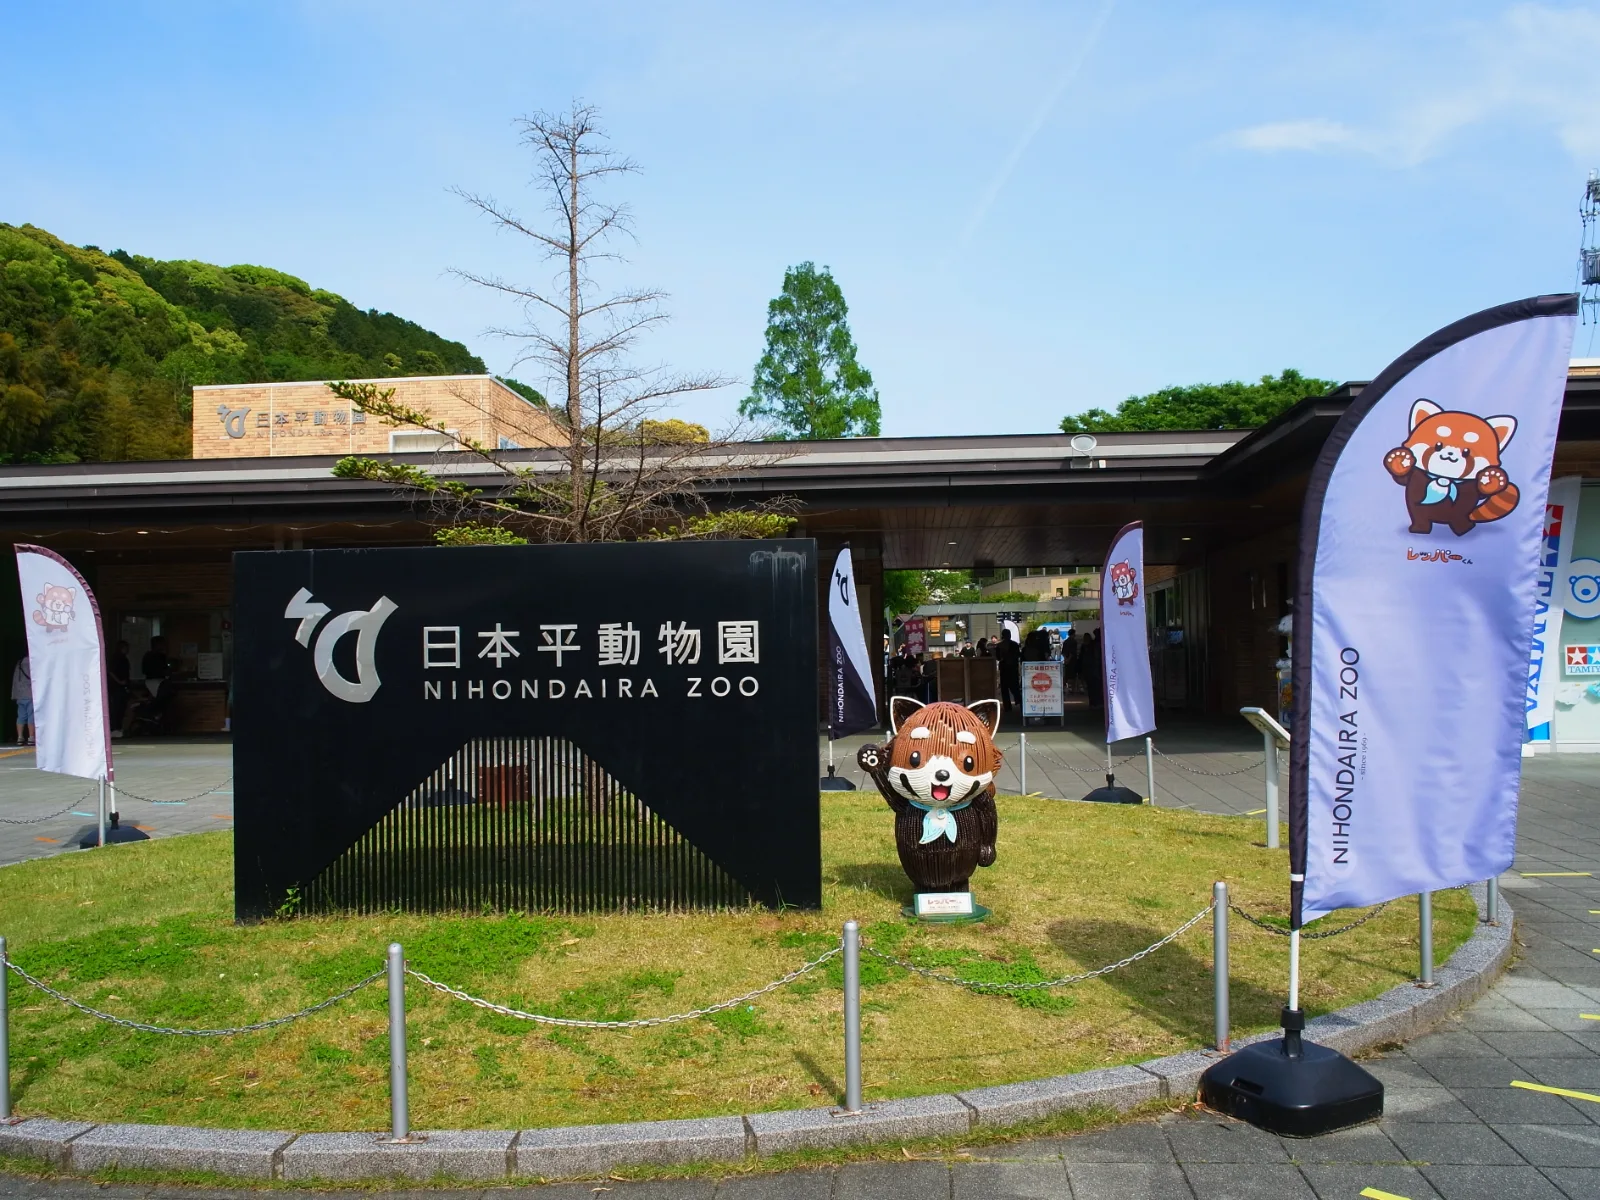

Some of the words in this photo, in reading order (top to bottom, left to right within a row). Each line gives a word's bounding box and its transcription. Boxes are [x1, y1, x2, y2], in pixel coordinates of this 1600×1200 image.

[256, 409, 366, 428] 日本平動物園
[1407, 547, 1473, 564] レッパーくん
[423, 620, 760, 669] 日本平動物園
[836, 646, 844, 665] ZOO
[1339, 646, 1360, 700] ZOO
[424, 678, 659, 700] NIHONDAIRA
[686, 676, 760, 698] ZOO
[837, 668, 845, 723] NIHONDAIRA
[1359, 755, 1367, 776] since
[1332, 710, 1358, 864] NIHONDAIRA
